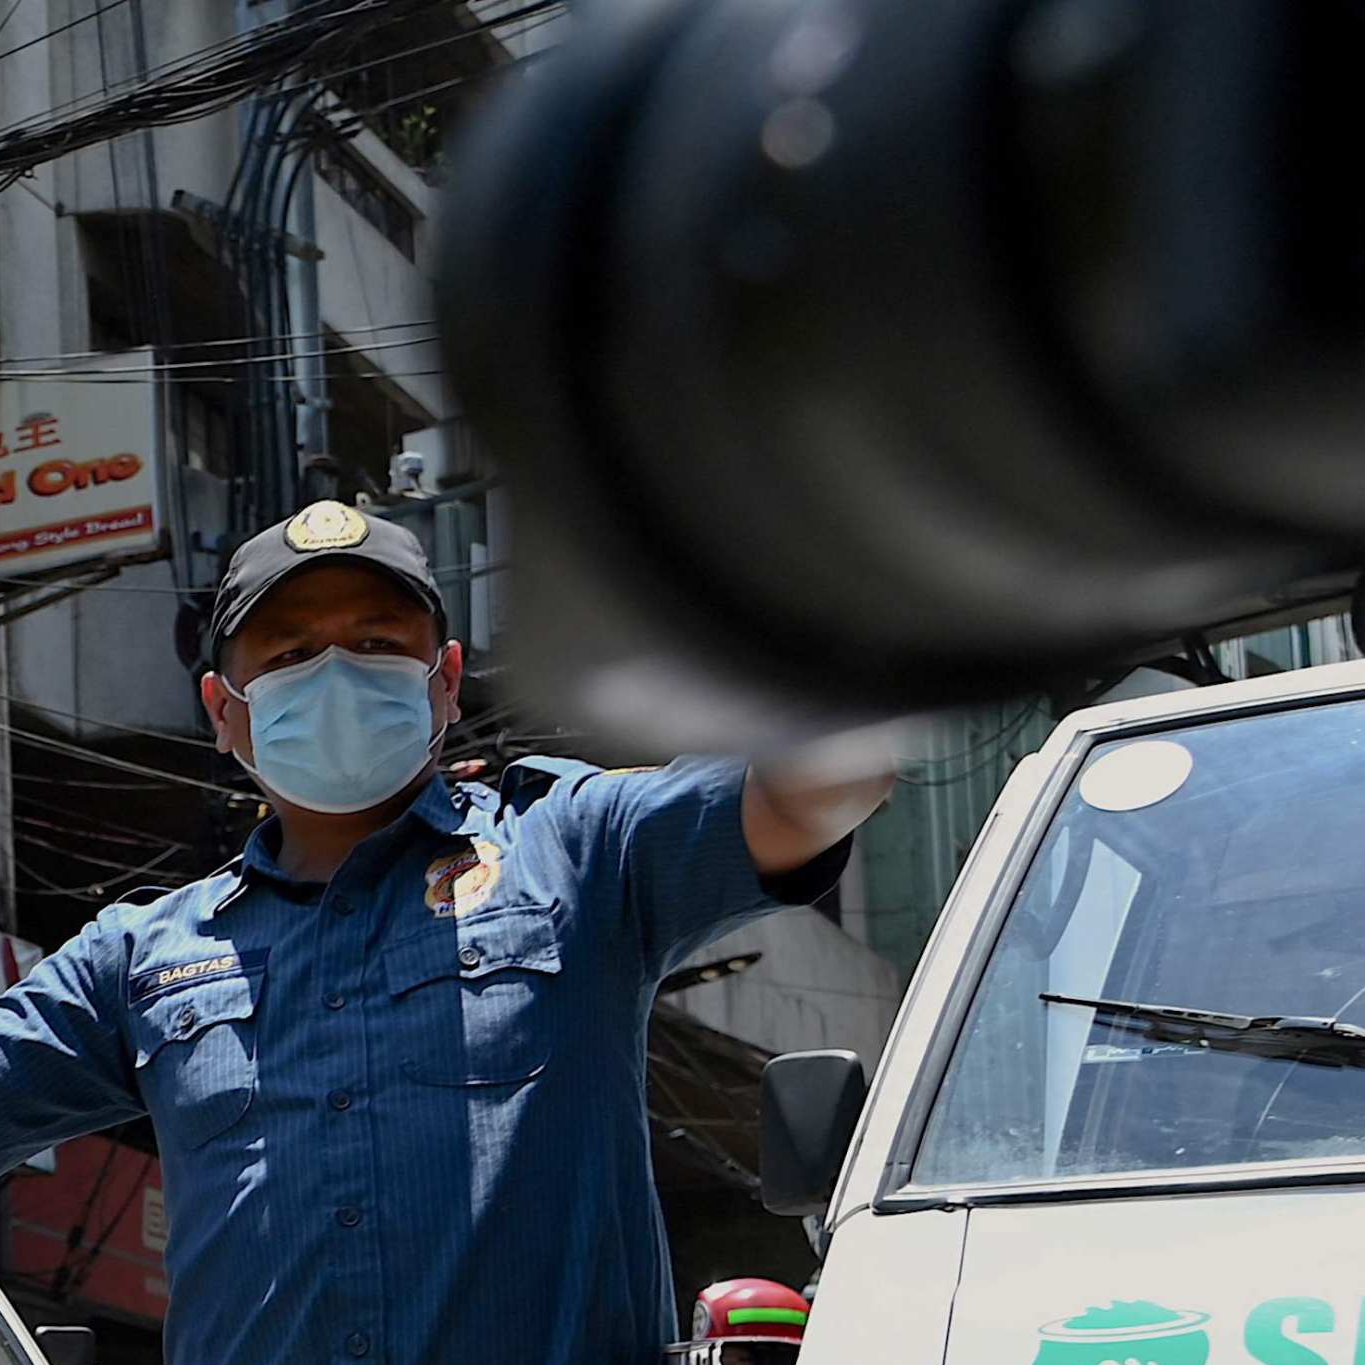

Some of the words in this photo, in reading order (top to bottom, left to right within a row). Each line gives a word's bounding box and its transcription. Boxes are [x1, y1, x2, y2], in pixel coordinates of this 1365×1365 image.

[27, 453, 142, 497] One
[34, 527, 81, 547] Style
[85, 512, 145, 534] Bread
[157, 955, 235, 986] BAGTAS
